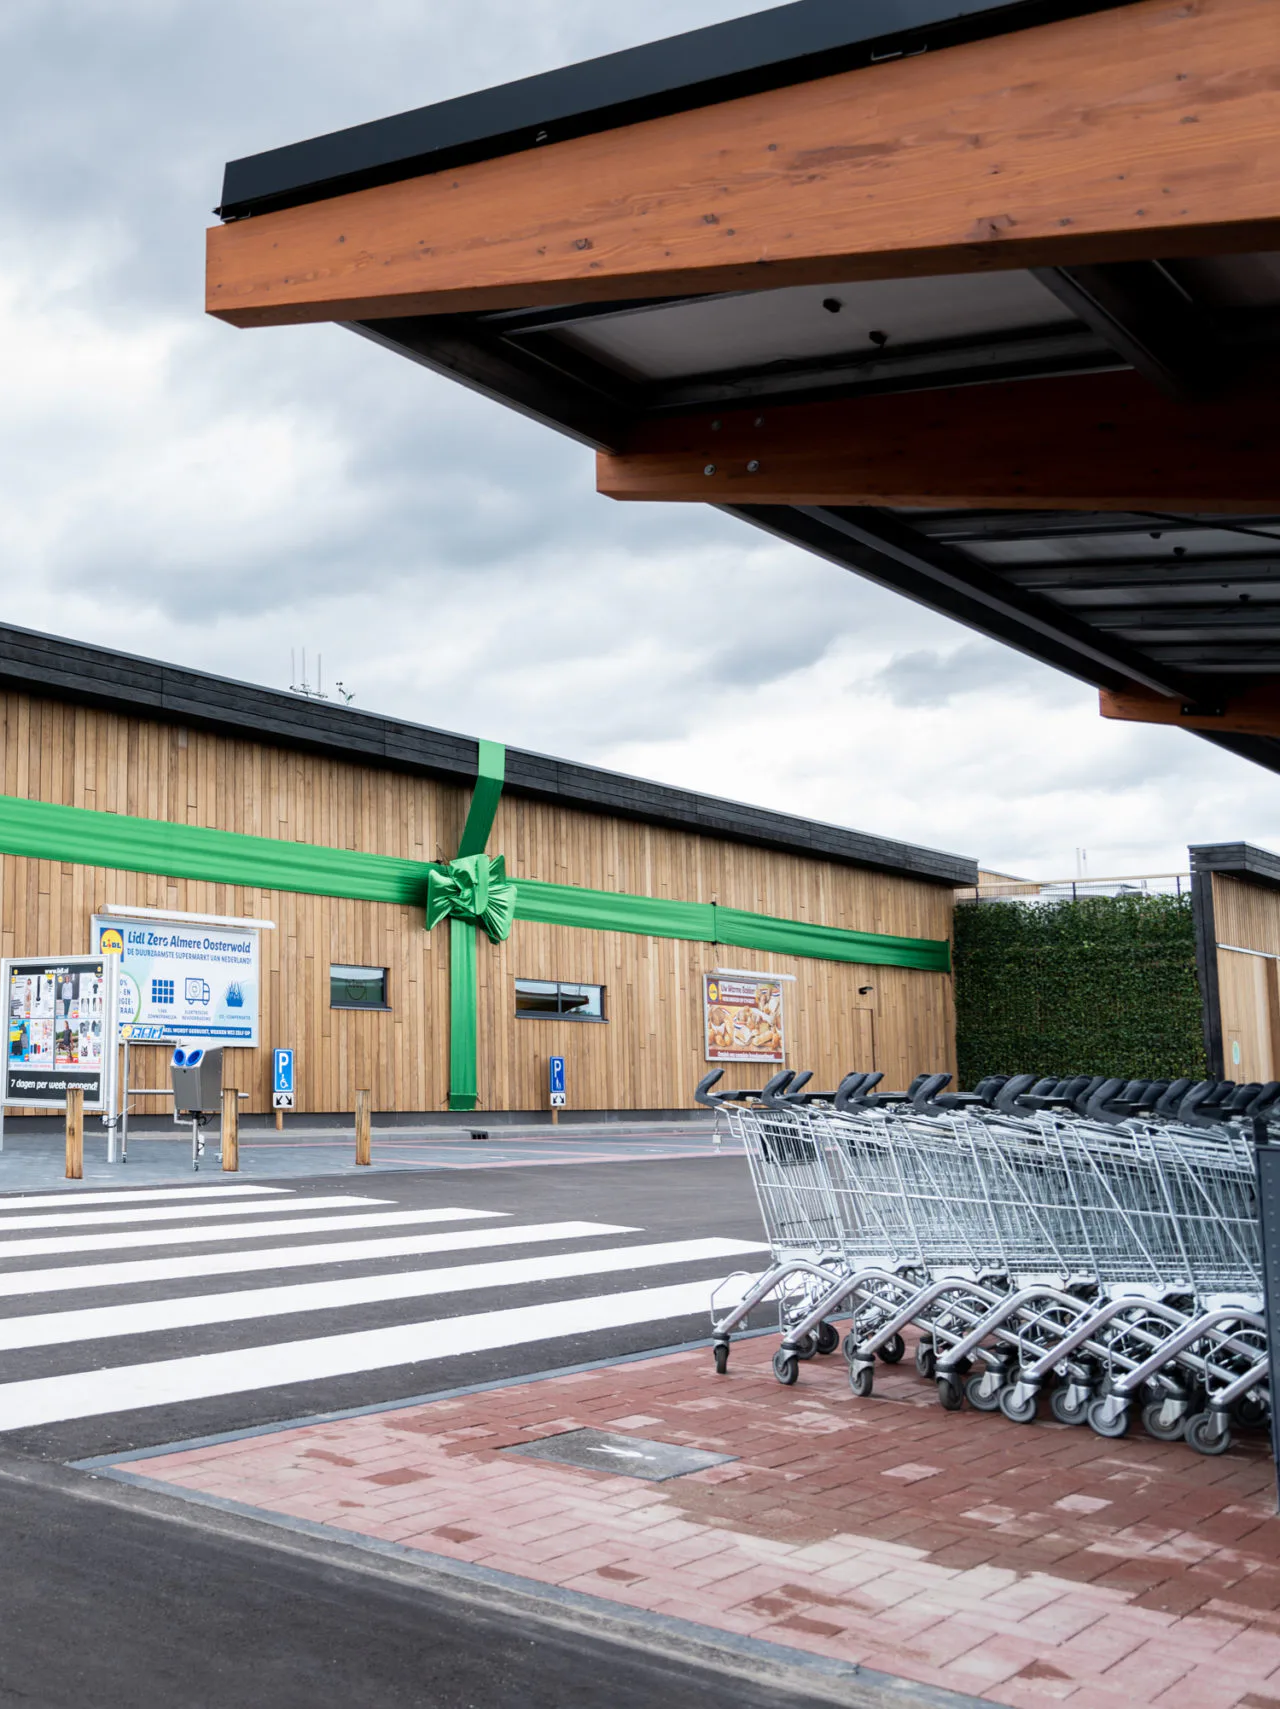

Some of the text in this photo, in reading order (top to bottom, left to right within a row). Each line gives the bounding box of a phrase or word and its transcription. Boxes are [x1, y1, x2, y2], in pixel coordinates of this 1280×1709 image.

[128, 931, 251, 953] Lidl Zero Almere Oosterwold
[135, 948, 174, 959] DUURZAAMSTE
[175, 951, 209, 961] SUPERMARKT
[210, 954, 220, 962] VAN
[221, 956, 252, 965] NEDERLAND!
[120, 1006, 135, 1015] RAAL
[279, 1052, 289, 1073] P
[554, 1060, 561, 1078] P
[10, 1079, 16, 1087] 7
[16, 1079, 35, 1090] dagen
[36, 1081, 48, 1090] per
[49, 1081, 66, 1089] week
